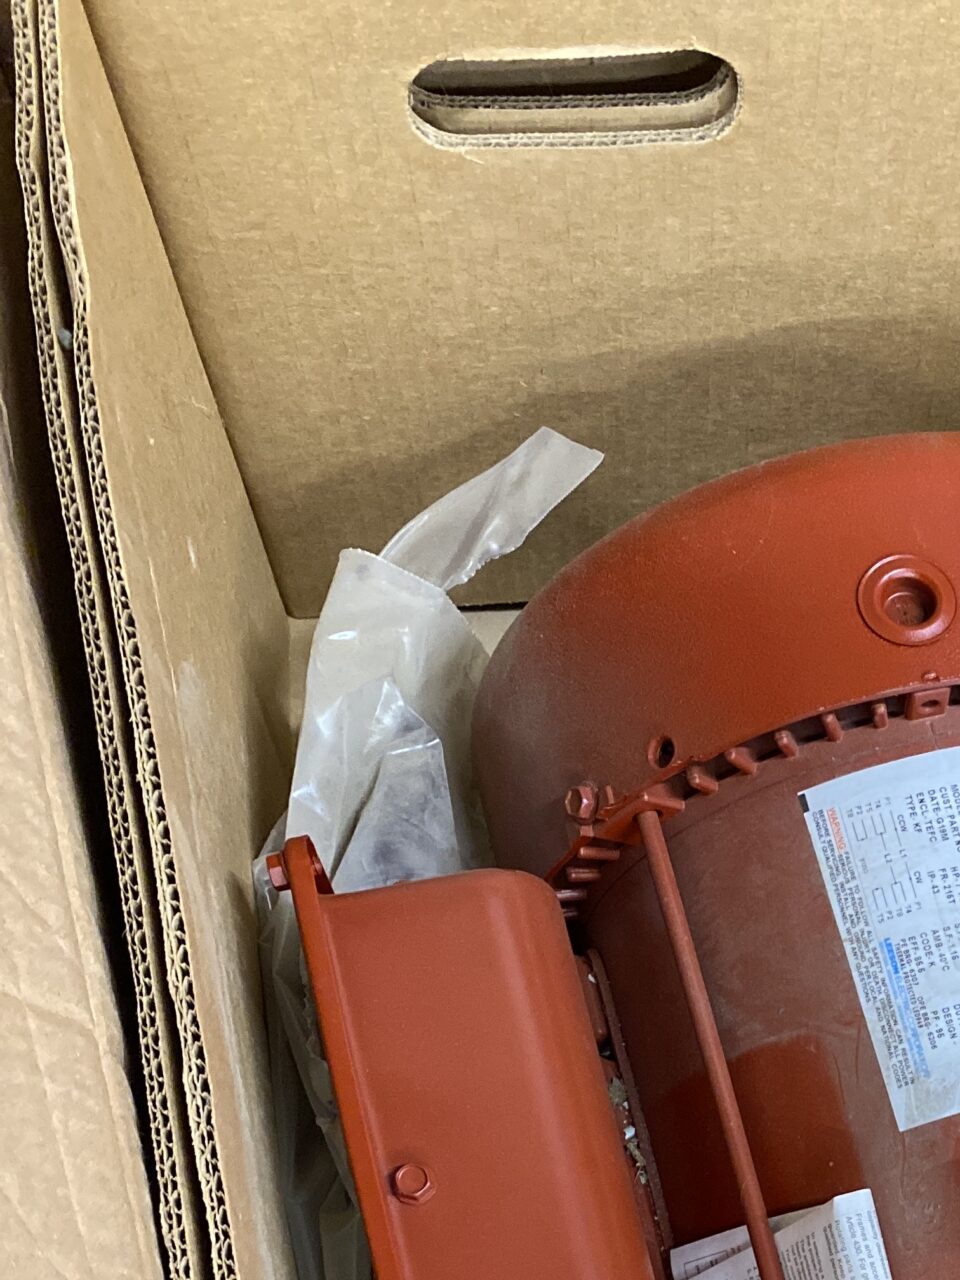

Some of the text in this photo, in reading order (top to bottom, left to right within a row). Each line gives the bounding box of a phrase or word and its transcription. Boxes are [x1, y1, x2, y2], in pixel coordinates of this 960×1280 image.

[827, 807, 846, 850] WARNING
[896, 814, 907, 832] CCW
[946, 813, 960, 837] PART
[883, 853, 891, 863] L2
[899, 848, 907, 857] L1
[913, 870, 922, 884] CW
[843, 851, 915, 1084] FAILURE TO FOLLOW ALL SAFETY INFORMATION CAN RESULT IN
[883, 937, 899, 974] LEESON
[893, 943, 916, 1005] THERMAL PROTECTED
[930, 1010, 939, 1021] PF
[941, 1006, 957, 1039] DESIGN
[845, 1215, 858, 1238] Article
[857, 1257, 867, 1270] For
[855, 1212, 868, 1241] Frames
[864, 1244, 873, 1258] and
